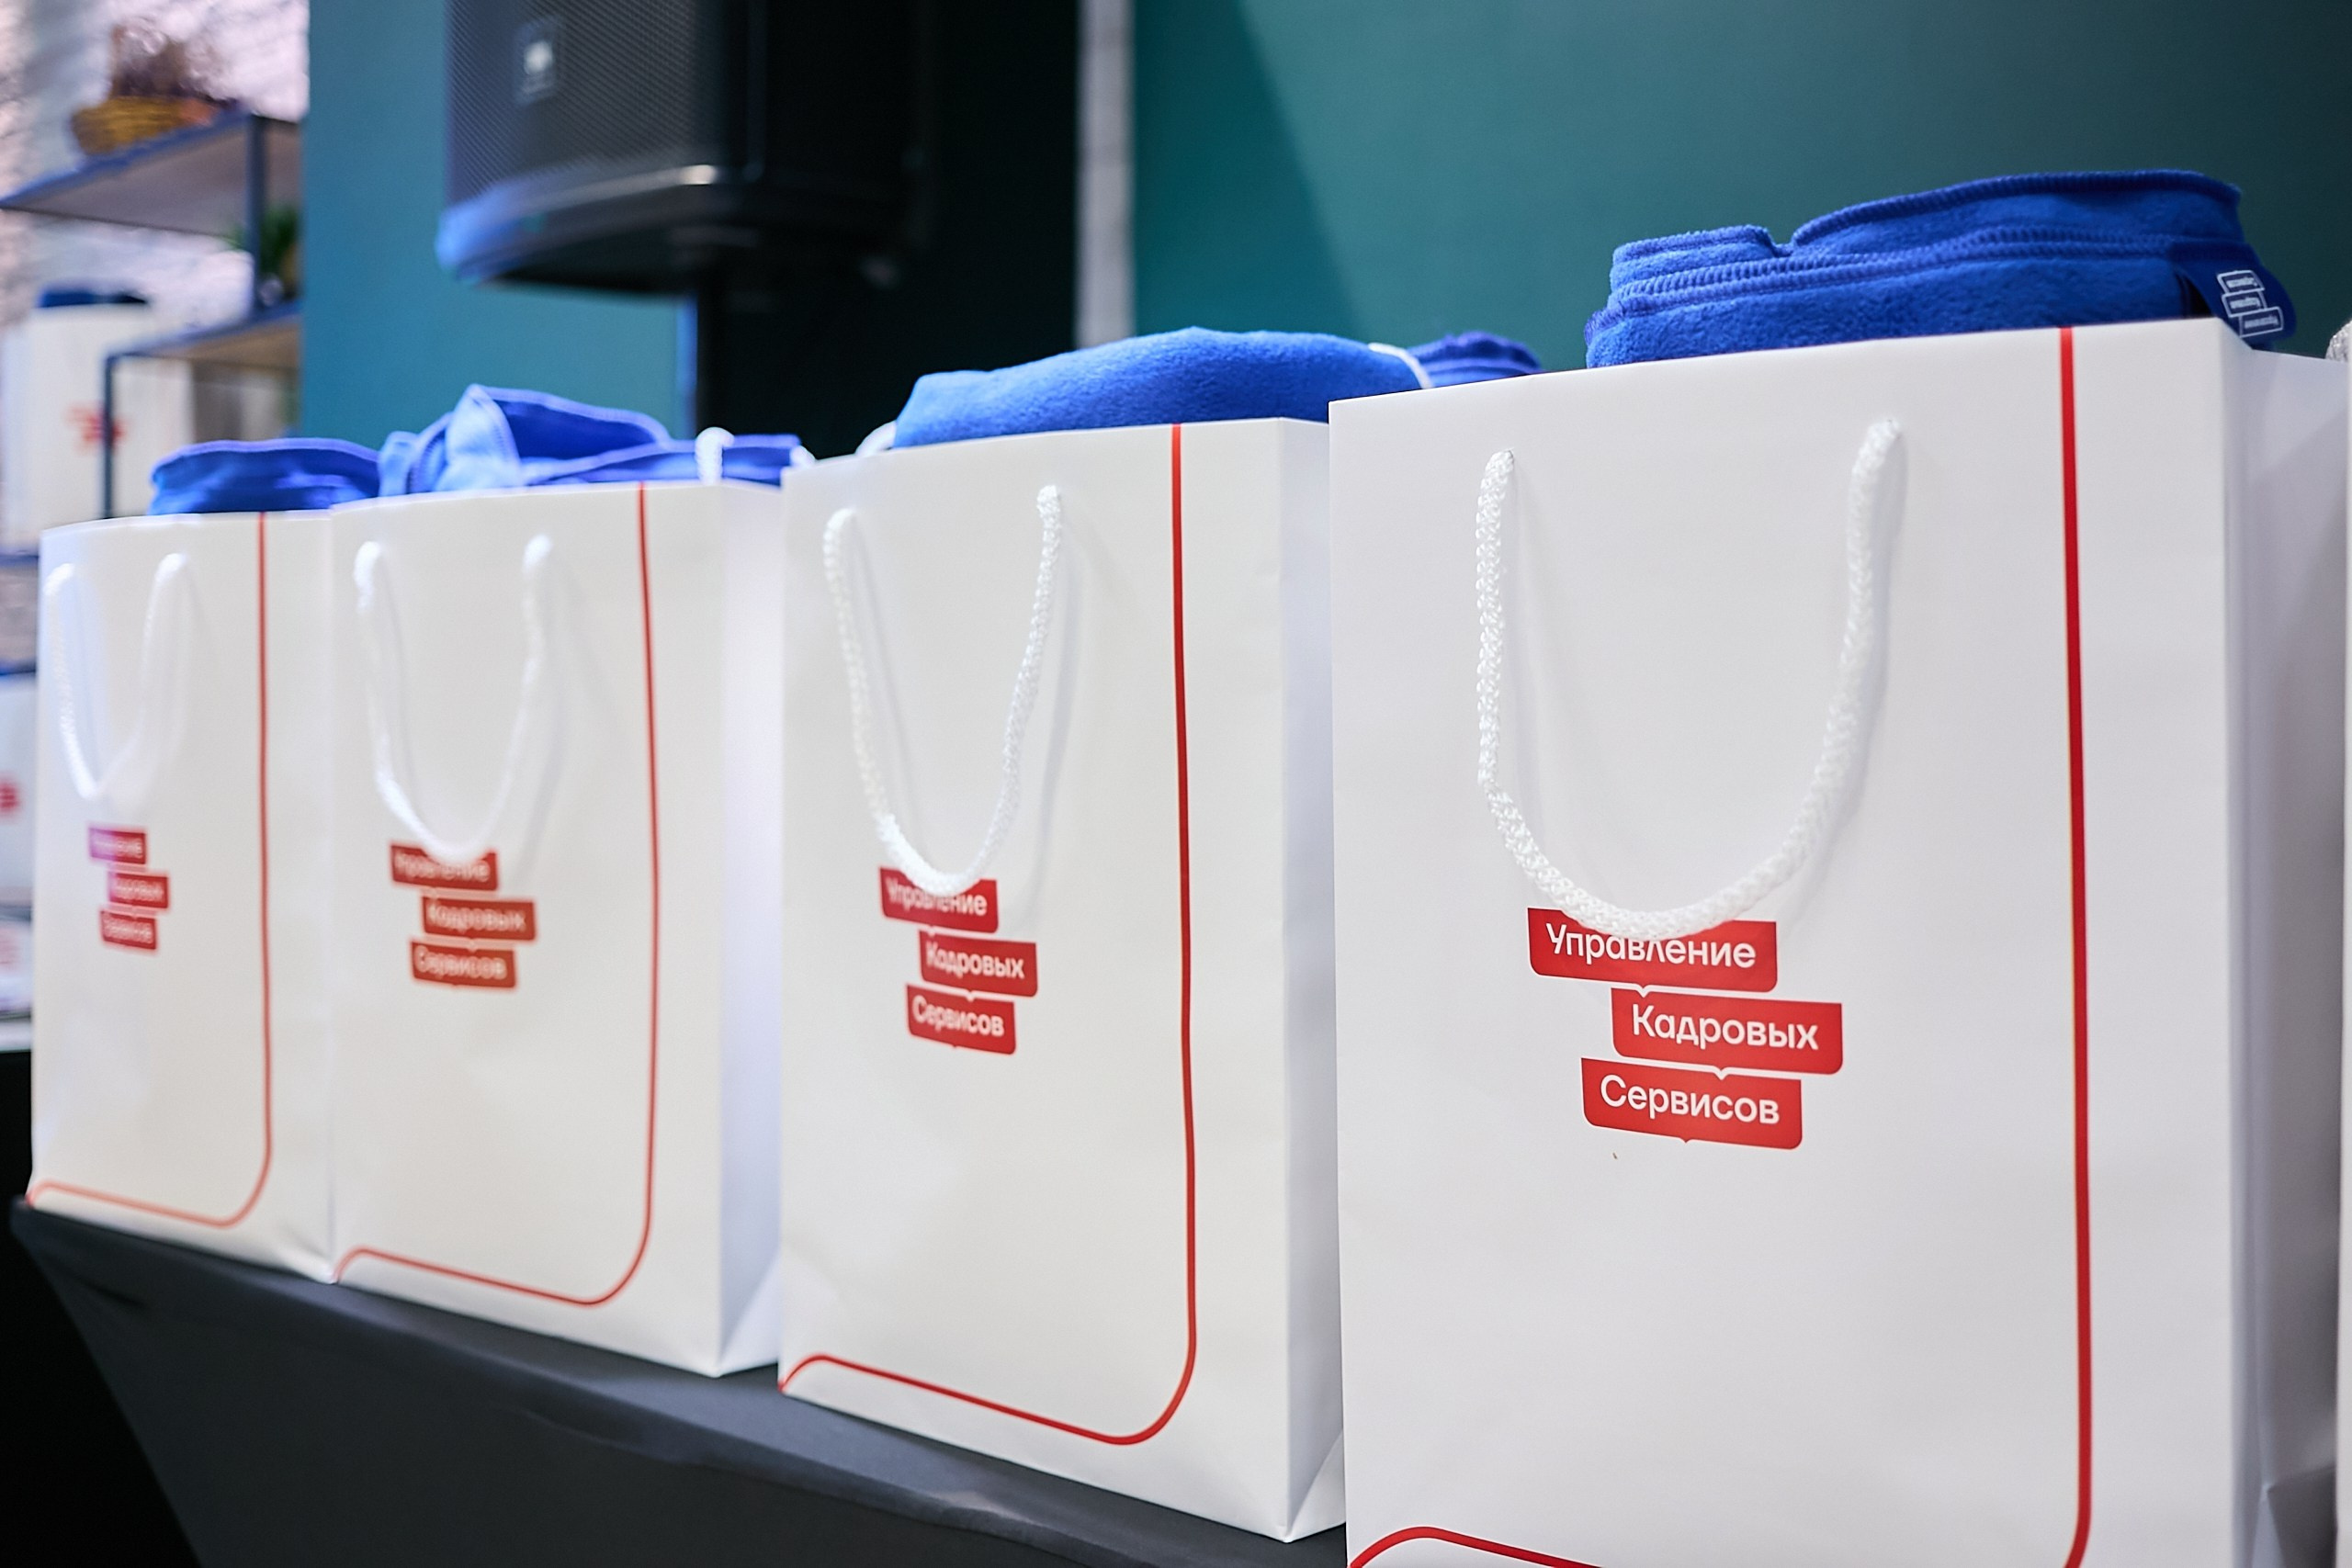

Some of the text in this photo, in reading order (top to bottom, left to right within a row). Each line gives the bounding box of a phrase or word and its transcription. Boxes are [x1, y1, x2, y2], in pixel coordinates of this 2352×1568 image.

[925, 940, 1025, 979] Кадровых
[1545, 922, 1757, 968] Управление
[911, 995, 1005, 1037] Сервисов
[1632, 1003, 1819, 1051] Кадровых
[1600, 1074, 1781, 1125] Сервисов
